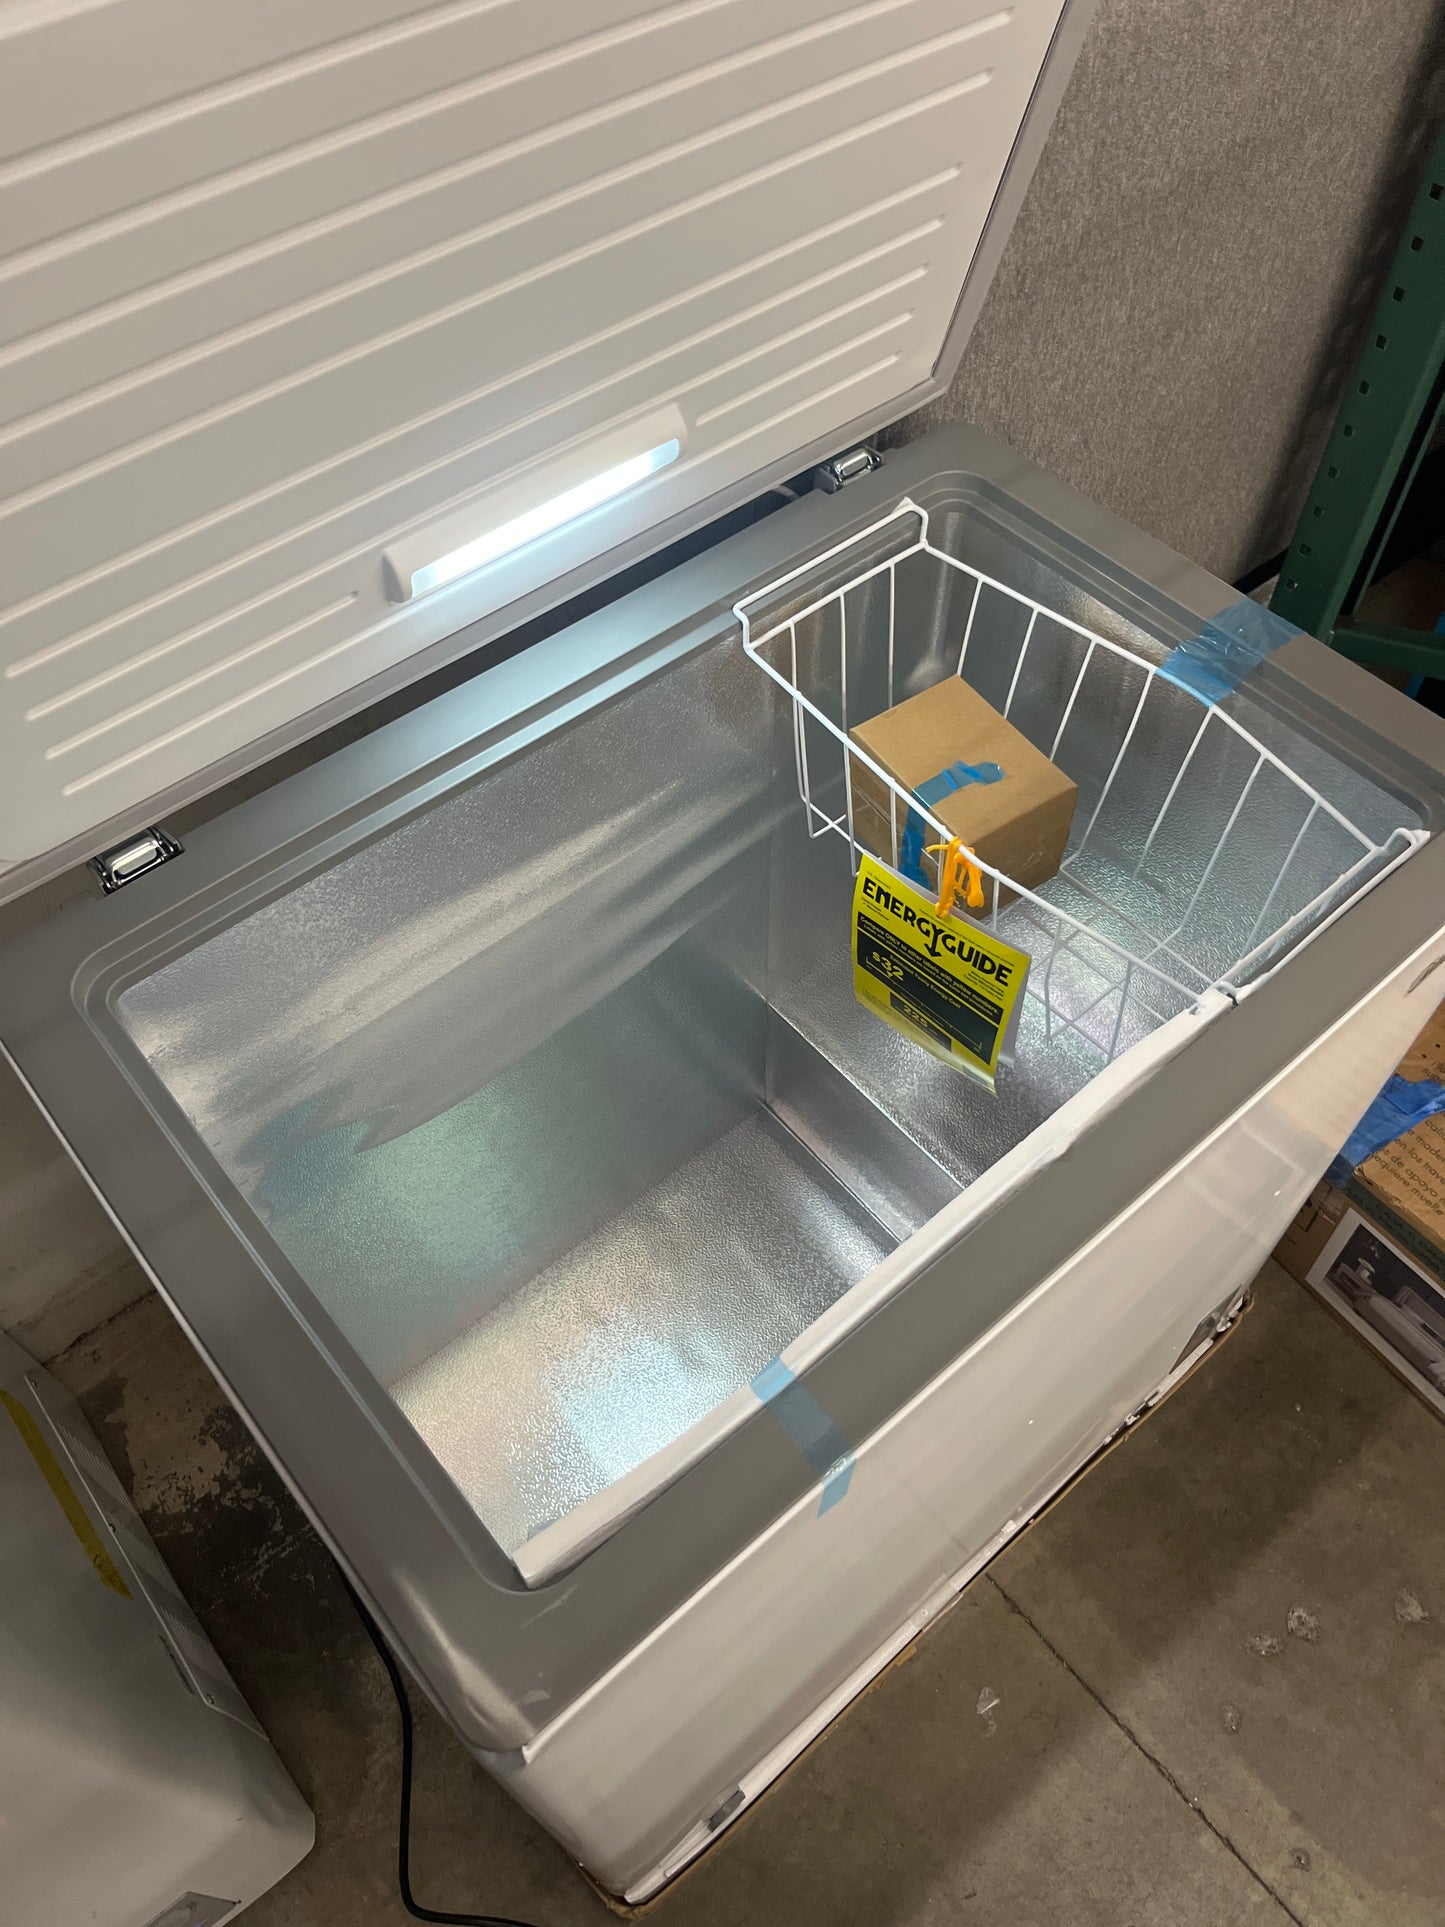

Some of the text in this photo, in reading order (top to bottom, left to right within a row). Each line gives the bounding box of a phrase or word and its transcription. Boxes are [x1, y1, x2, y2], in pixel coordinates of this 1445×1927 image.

[863, 877, 1012, 987] ENERGYGUIDE
[860, 915, 884, 936] Compare
[885, 932, 899, 946] ONLY
[900, 943, 907, 951] to
[907, 948, 922, 962] other
[940, 970, 952, 982] with
[952, 979, 970, 996] yellow
[872, 951, 904, 981] $32
[1408, 1147, 1422, 1163] los
[1391, 1155, 1404, 1168] de
[1406, 1168, 1438, 1198] apoyo
[1411, 1187, 1444, 1216] muelle
